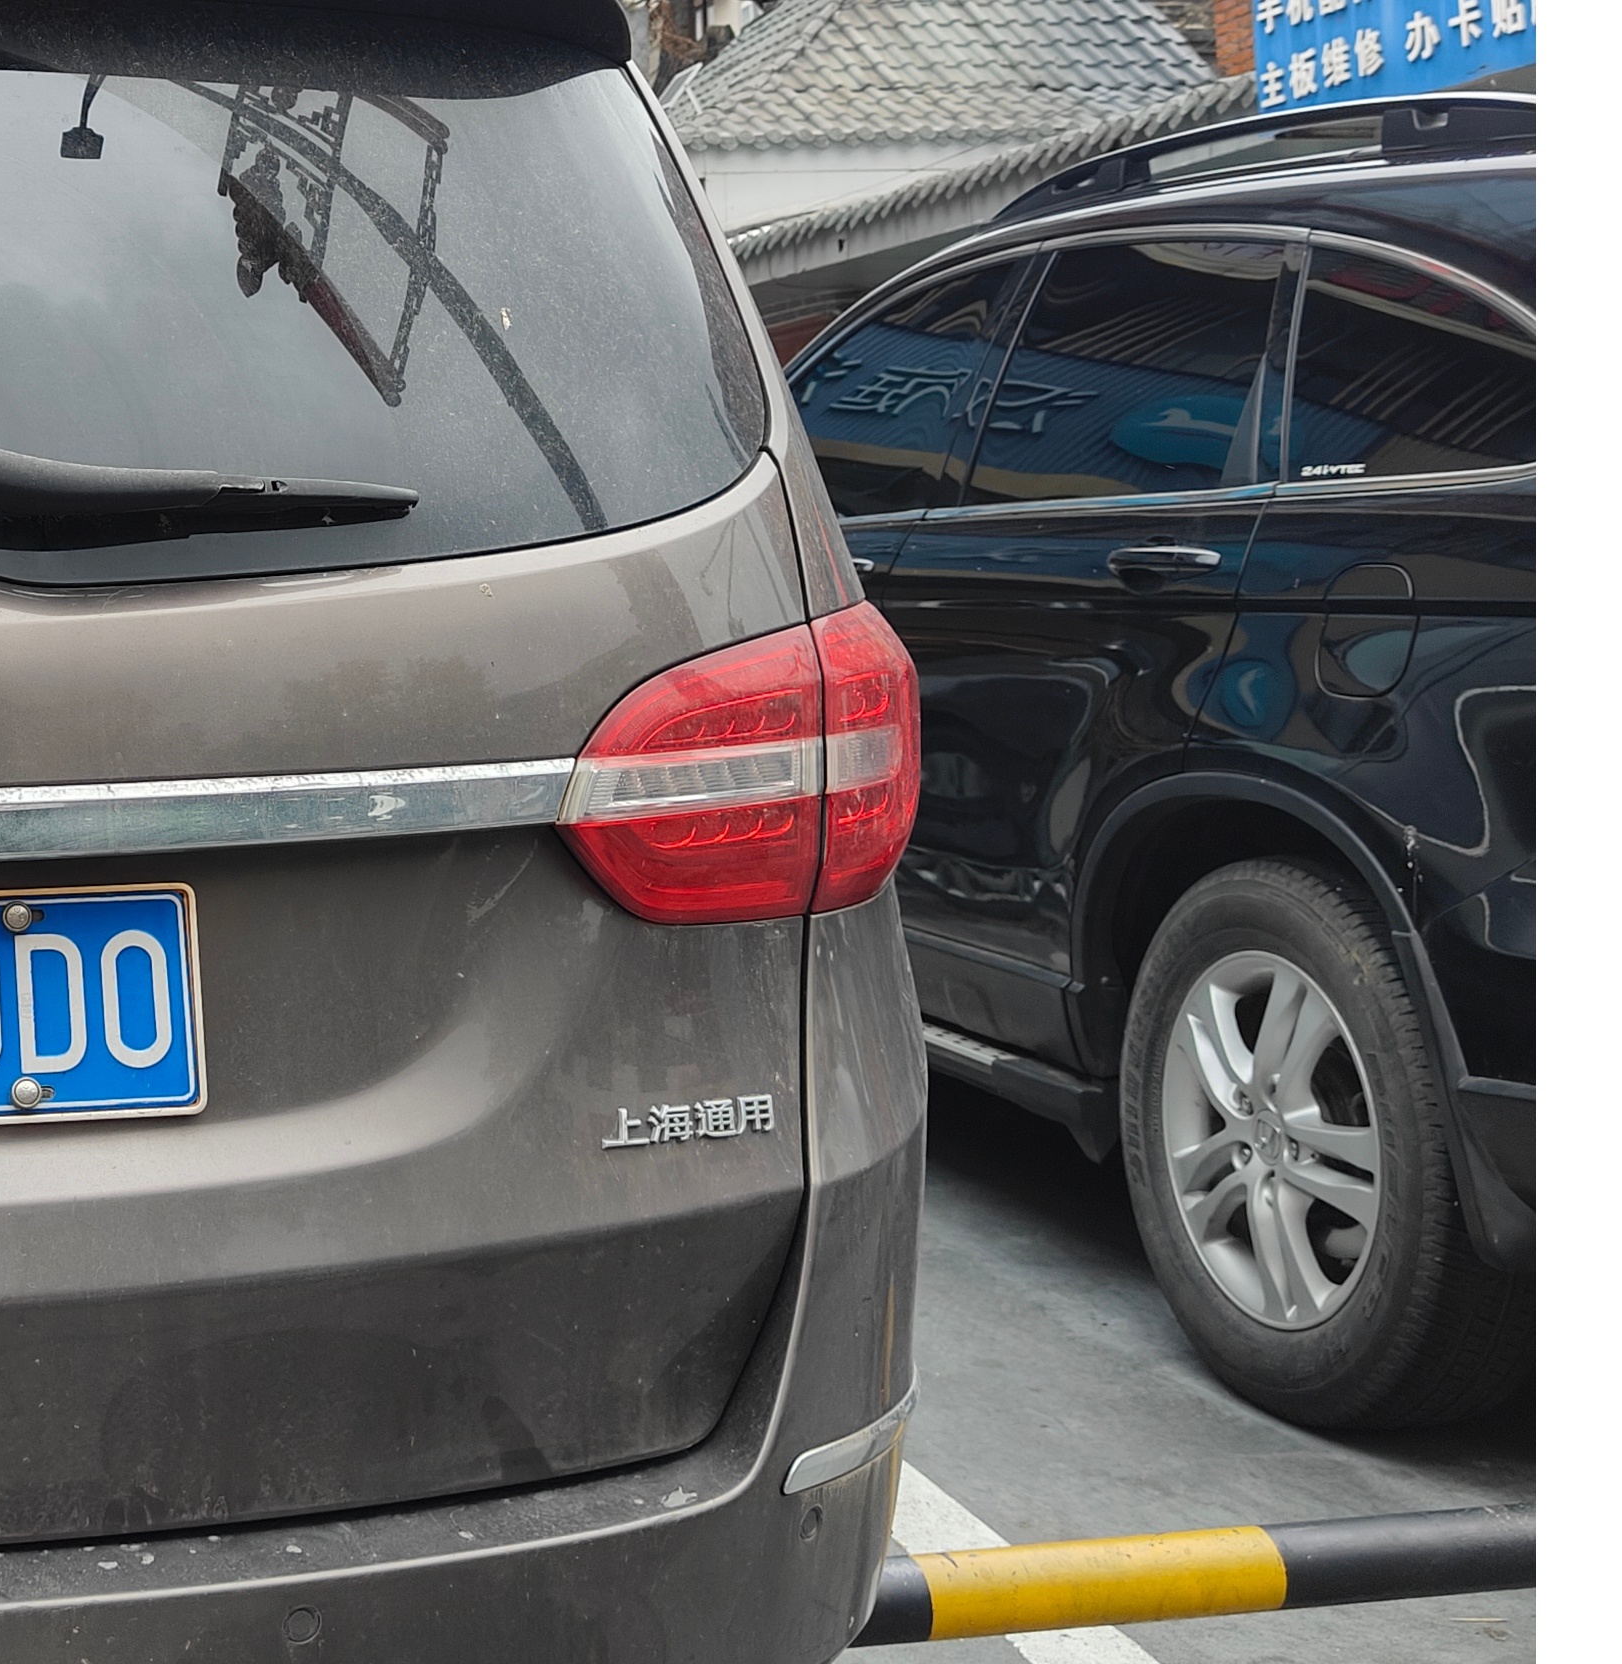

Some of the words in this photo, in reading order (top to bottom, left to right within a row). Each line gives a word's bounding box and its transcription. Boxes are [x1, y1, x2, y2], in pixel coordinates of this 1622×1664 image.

[1259, 28, 1386, 110] 主板维修
[601, 1094, 775, 1150] 上海通用
